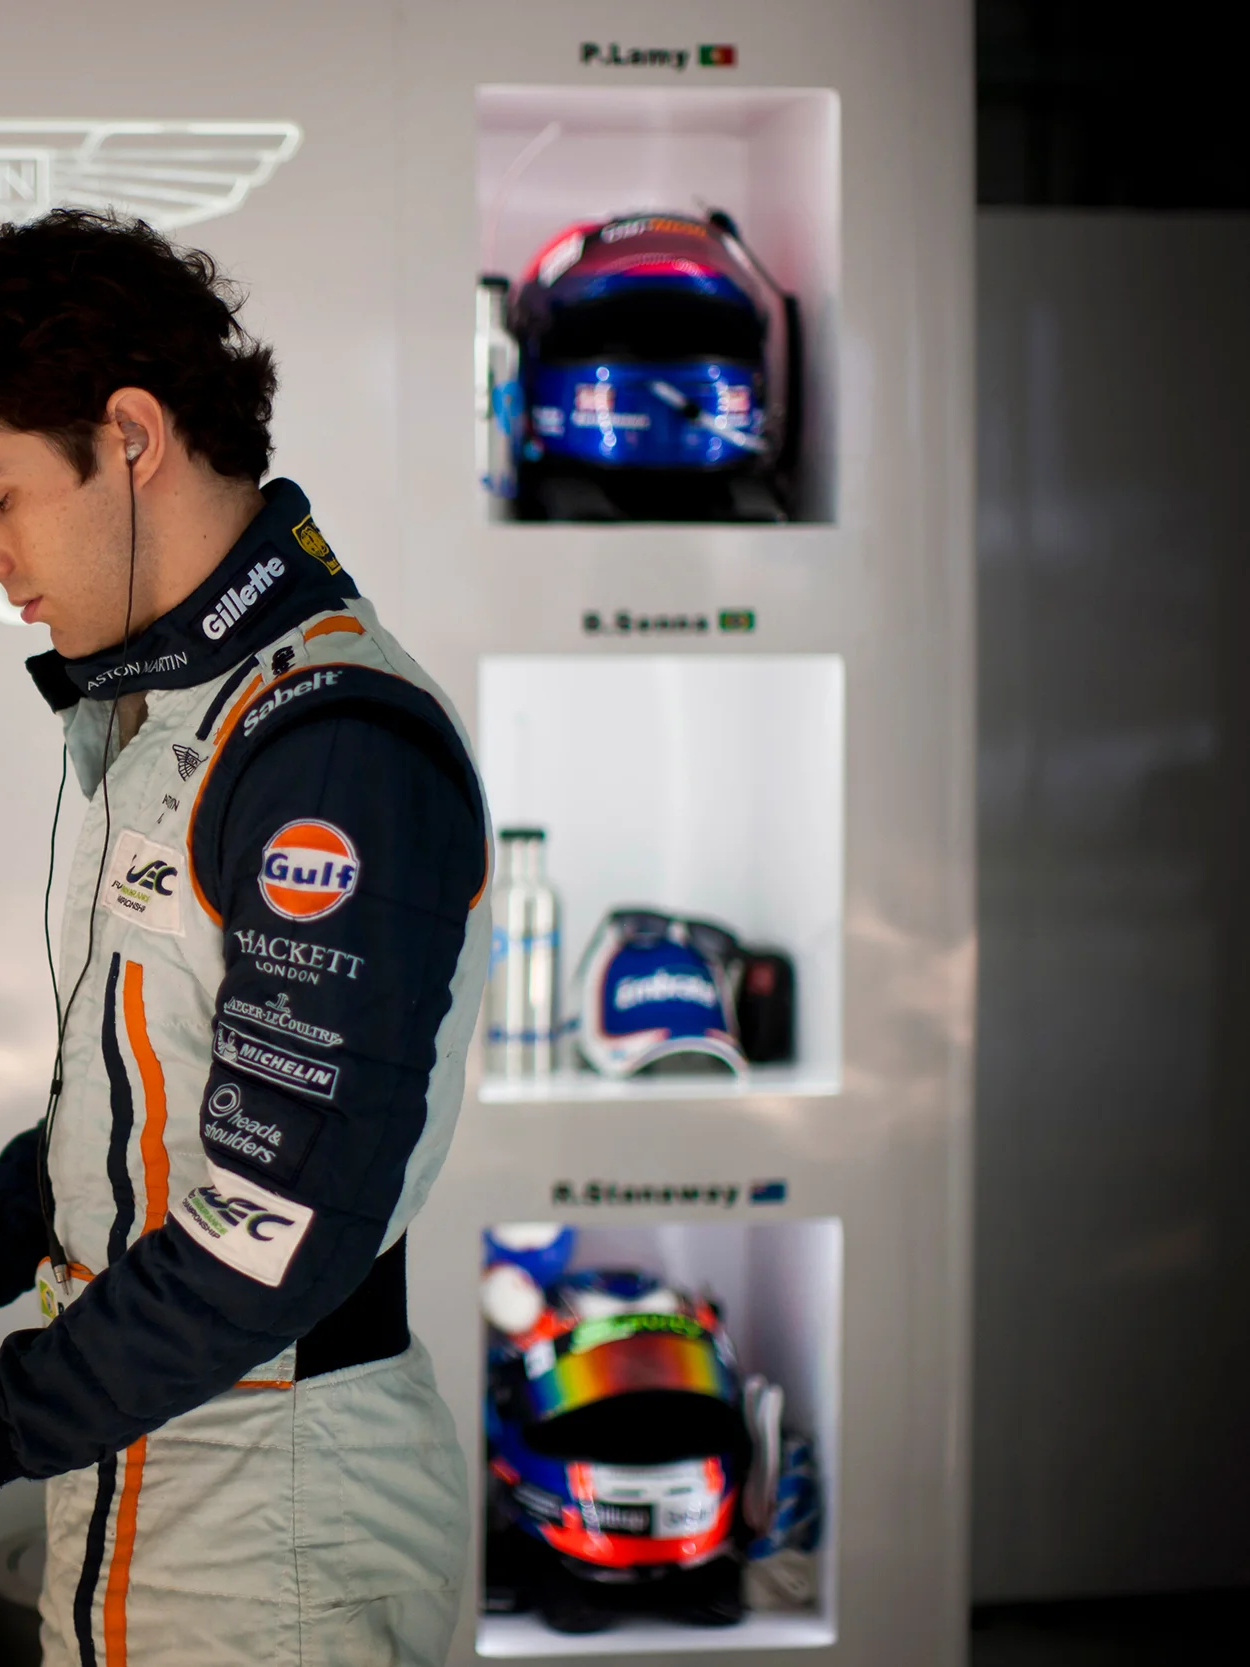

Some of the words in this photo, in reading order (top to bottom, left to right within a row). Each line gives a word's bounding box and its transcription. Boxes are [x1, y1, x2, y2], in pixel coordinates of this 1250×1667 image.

[581, 42, 689, 72] P.Lamy
[202, 556, 286, 640] Gillette
[87, 663, 141, 691] ASTON
[142, 651, 188, 674] MARTIN
[244, 669, 339, 738] Sabelt
[265, 852, 355, 890] Gulf
[234, 929, 365, 979] HACKETT
[255, 960, 320, 986] LONDON
[239, 1043, 332, 1085] MICHELIN
[204, 1121, 276, 1163] shoulders
